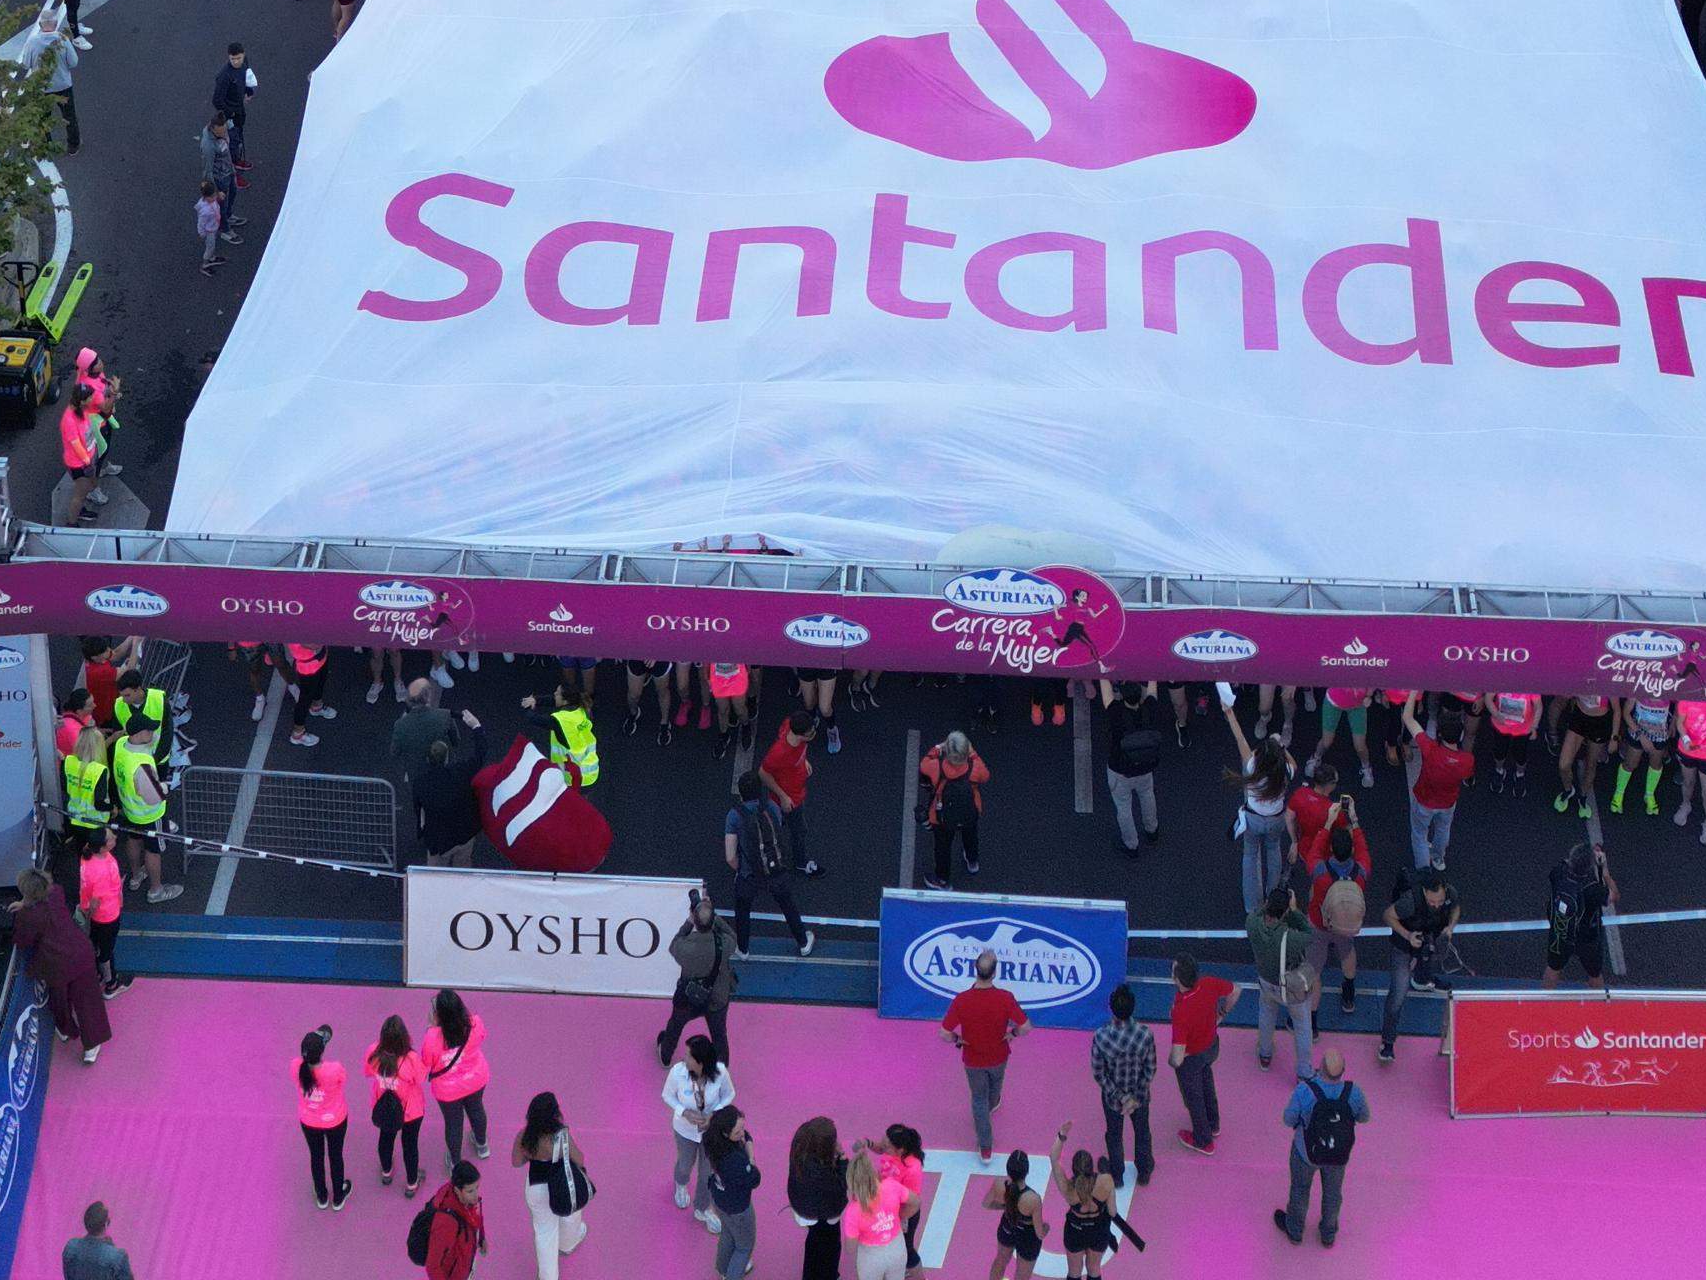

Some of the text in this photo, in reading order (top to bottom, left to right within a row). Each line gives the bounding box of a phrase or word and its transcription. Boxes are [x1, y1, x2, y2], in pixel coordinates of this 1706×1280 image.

[91, 592, 163, 612] ASTURIANA
[365, 588, 430, 603] ASTURIANA
[950, 582, 1056, 607] ASTURIANA
[221, 597, 305, 616] OYSHO
[352, 605, 418, 624] Carrera
[527, 619, 595, 636] Santander
[647, 614, 731, 633] OYSHO
[931, 608, 1031, 637] Carrera
[390, 621, 439, 647] Mujer
[791, 624, 864, 642] ASTURIANA
[955, 634, 1069, 674] de la Mujer
[1178, 641, 1252, 657] ASTURIANA
[1443, 645, 1530, 664] OYSHO
[1613, 638, 1679, 654] ASTURIANA
[1321, 655, 1390, 668] Santander
[1597, 653, 1662, 673] Carrera
[1634, 669, 1686, 697] Mujer
[449, 910, 661, 958] OYSHO
[924, 945, 1082, 986] ASTRIANA
[1508, 1030, 1572, 1052] Sports
